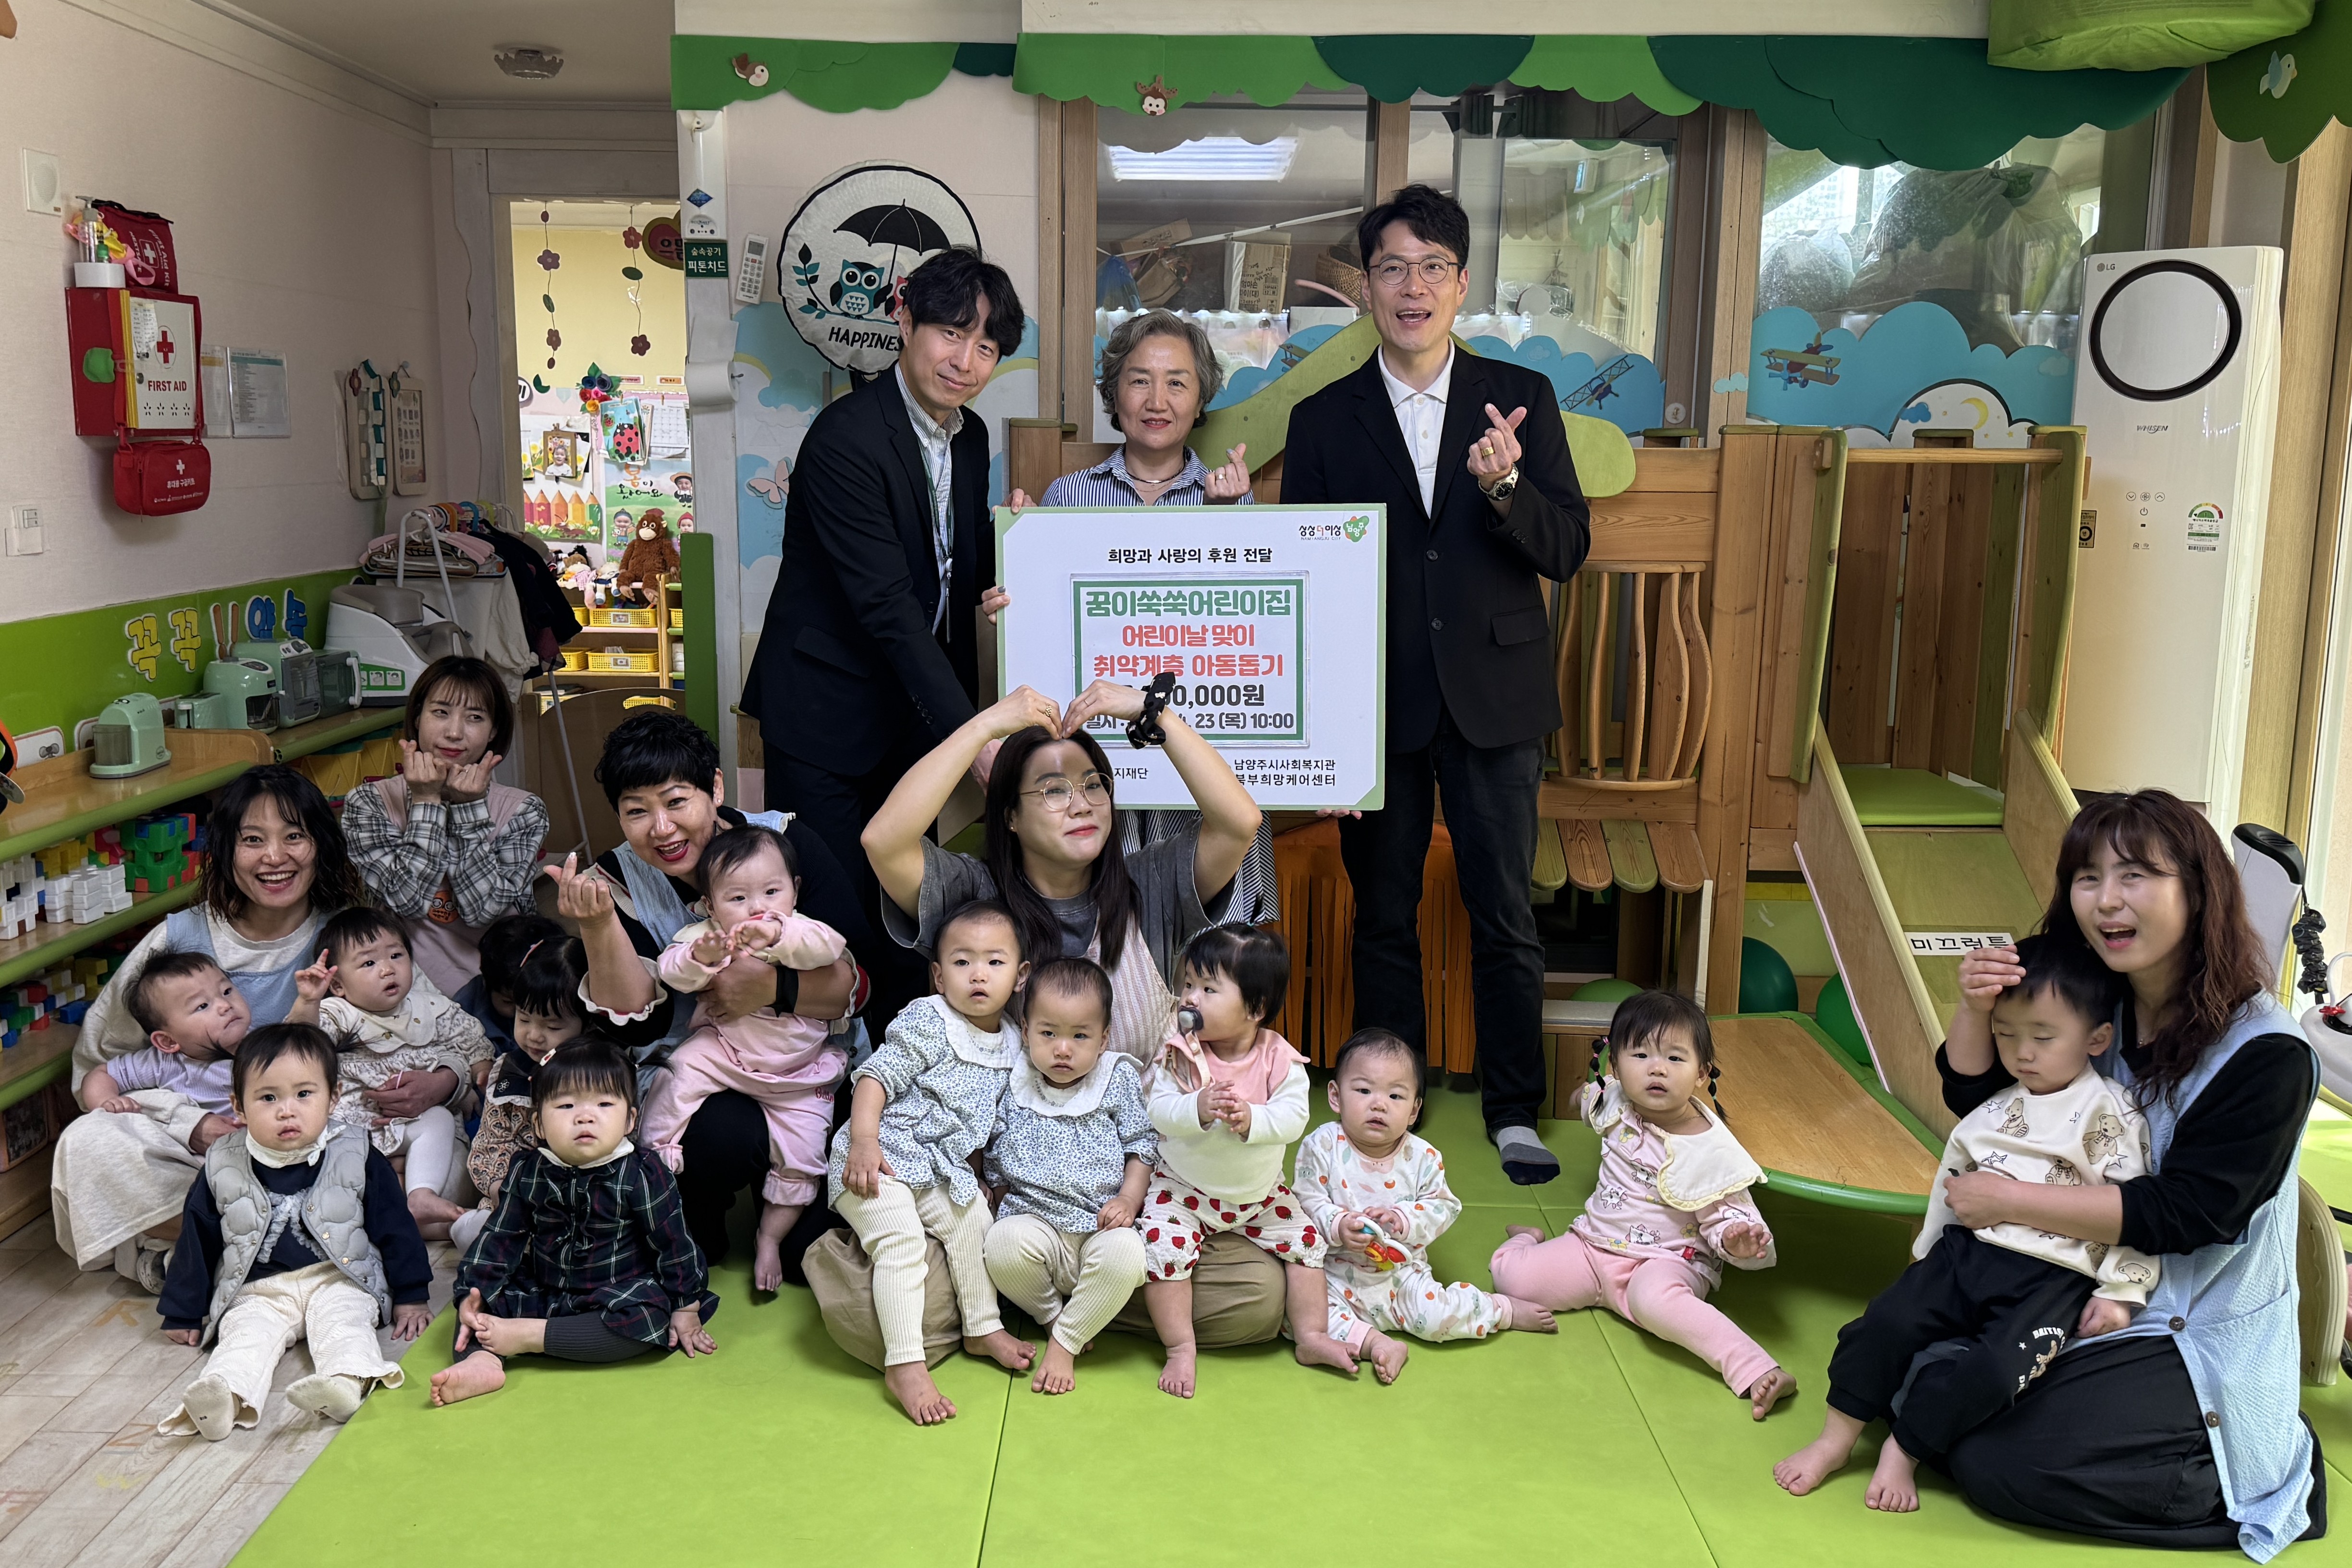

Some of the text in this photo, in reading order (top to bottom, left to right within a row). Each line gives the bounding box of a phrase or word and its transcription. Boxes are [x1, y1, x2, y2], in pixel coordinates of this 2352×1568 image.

[129, 231, 142, 273] NEXTSAE
[691, 247, 721, 256] 숲속공기
[161, 251, 170, 269] Aid
[688, 260, 727, 273] 피톤치드
[148, 380, 186, 391] FIRST AID
[2137, 425, 2168, 434] WHISEN
[1347, 523, 1364, 537] 남양주
[1108, 548, 1273, 563] 희망과 사랑의 후원 전달
[1086, 589, 1291, 616] 꿈이쑥쑥어린이집
[1122, 625, 1254, 647] 어린이날 맞이
[1094, 654, 1283, 677] 취약계층 아동돕기
[1195, 713, 1215, 728] 23
[1219, 712, 1247, 729] (목)
[1250, 713, 1294, 728] 10:00
[1235, 759, 1335, 771] 남양주시사회복지관
[1114, 767, 1148, 779] 지재단
[1236, 774, 1335, 786] 북부희망케어센터
